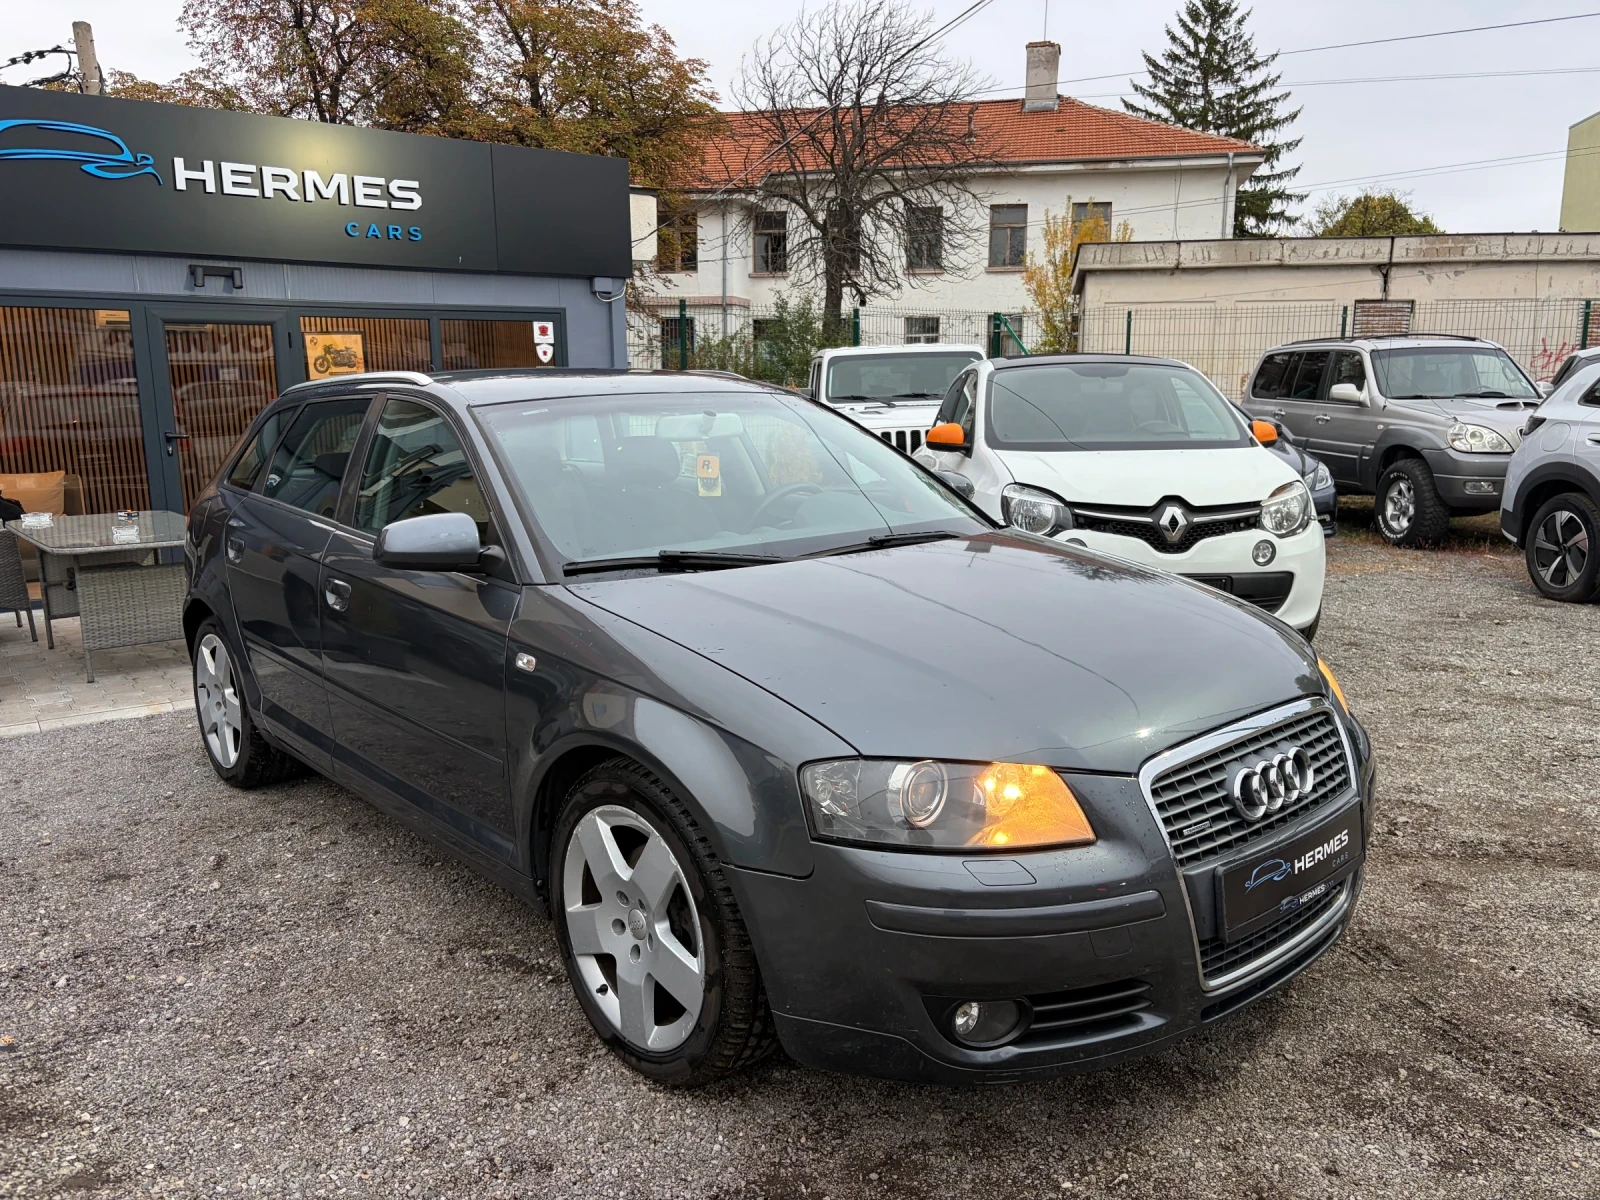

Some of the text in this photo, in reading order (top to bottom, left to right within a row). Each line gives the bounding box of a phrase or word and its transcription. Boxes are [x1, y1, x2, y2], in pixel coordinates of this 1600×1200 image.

[173, 157, 422, 211] HERMES
[345, 222, 422, 242] CARS
[1294, 829, 1349, 875] HERMES
[1332, 851, 1349, 867] CARS
[1299, 883, 1326, 905] HERMES
